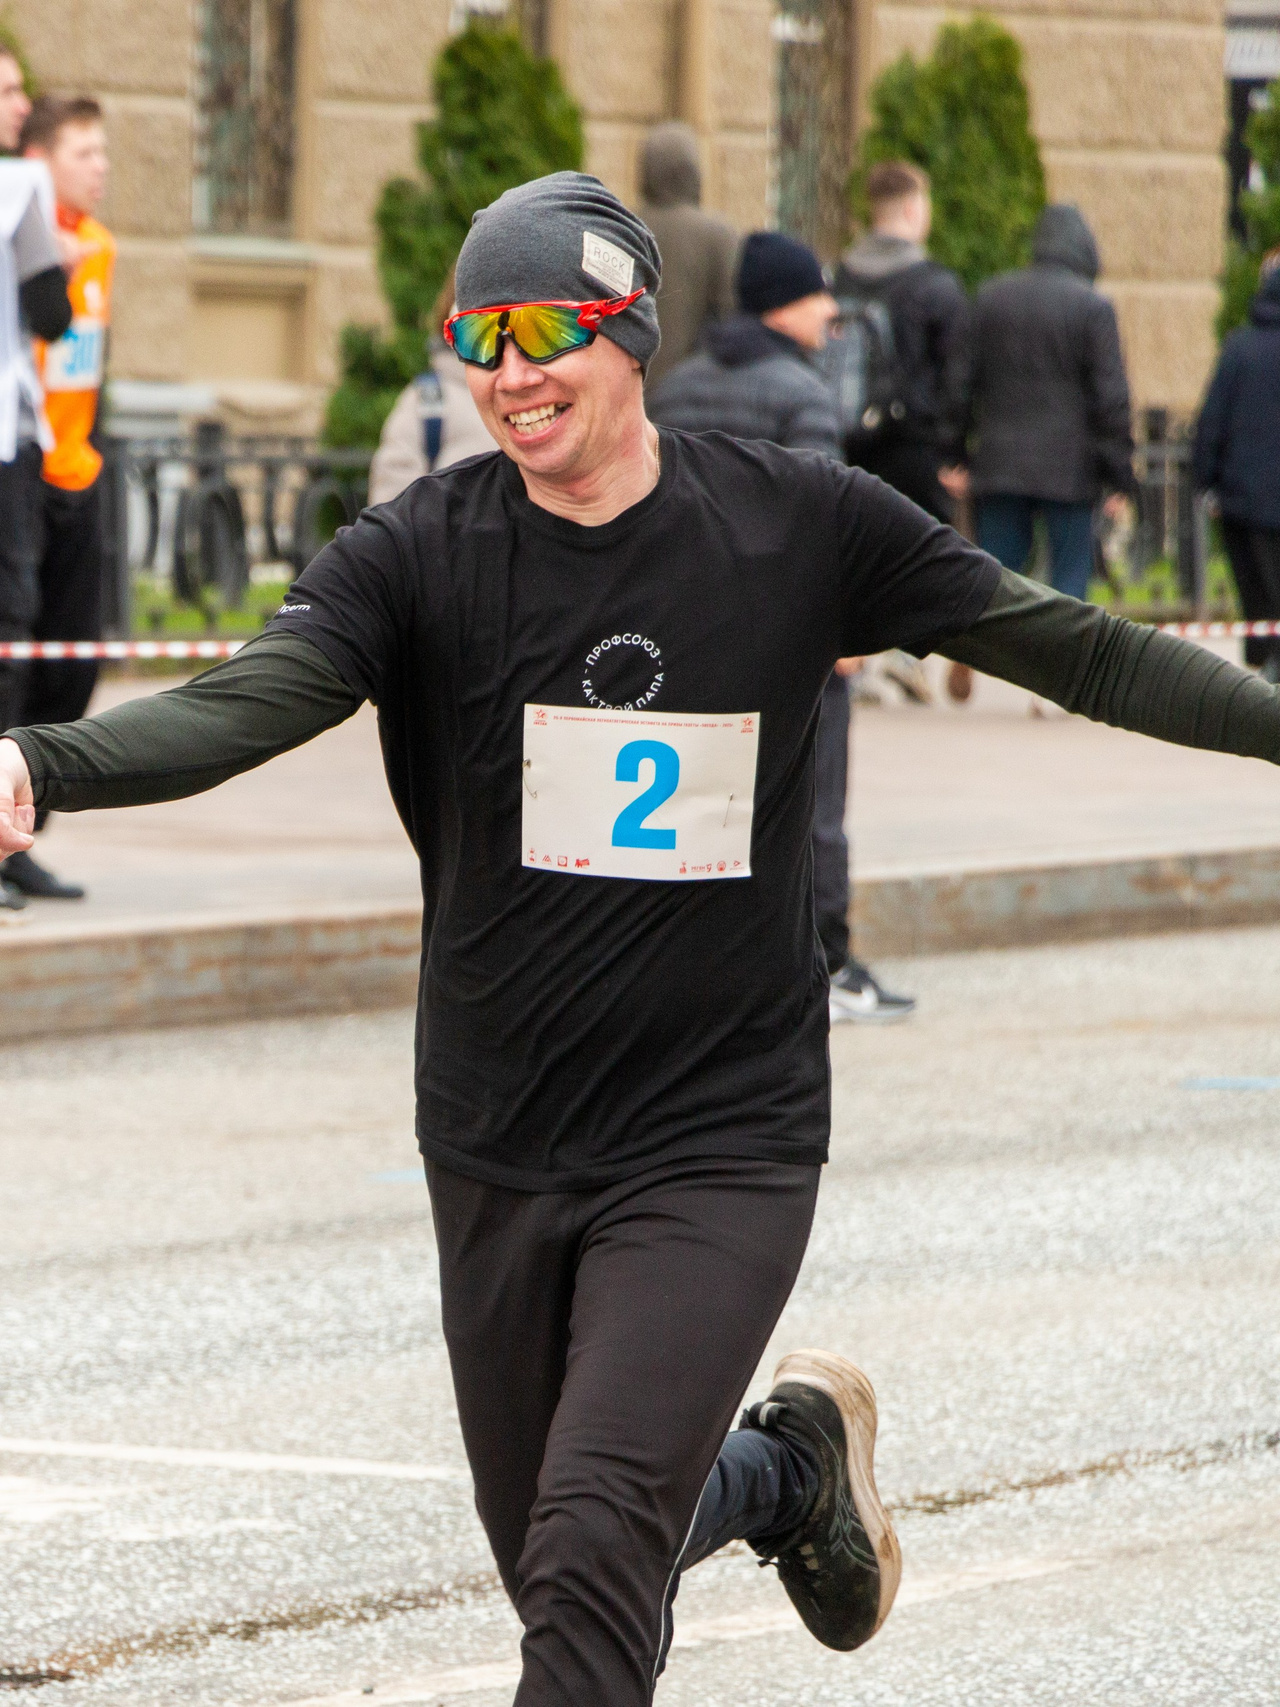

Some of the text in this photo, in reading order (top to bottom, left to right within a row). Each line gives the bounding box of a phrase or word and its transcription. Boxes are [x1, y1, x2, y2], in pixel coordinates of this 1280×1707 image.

[593, 246, 625, 273] ROCK
[585, 633, 661, 666] ПРОФСОЮЗ
[582, 679, 599, 705] КАК
[635, 672, 664, 709] ПАПА
[612, 739, 680, 850] 2
